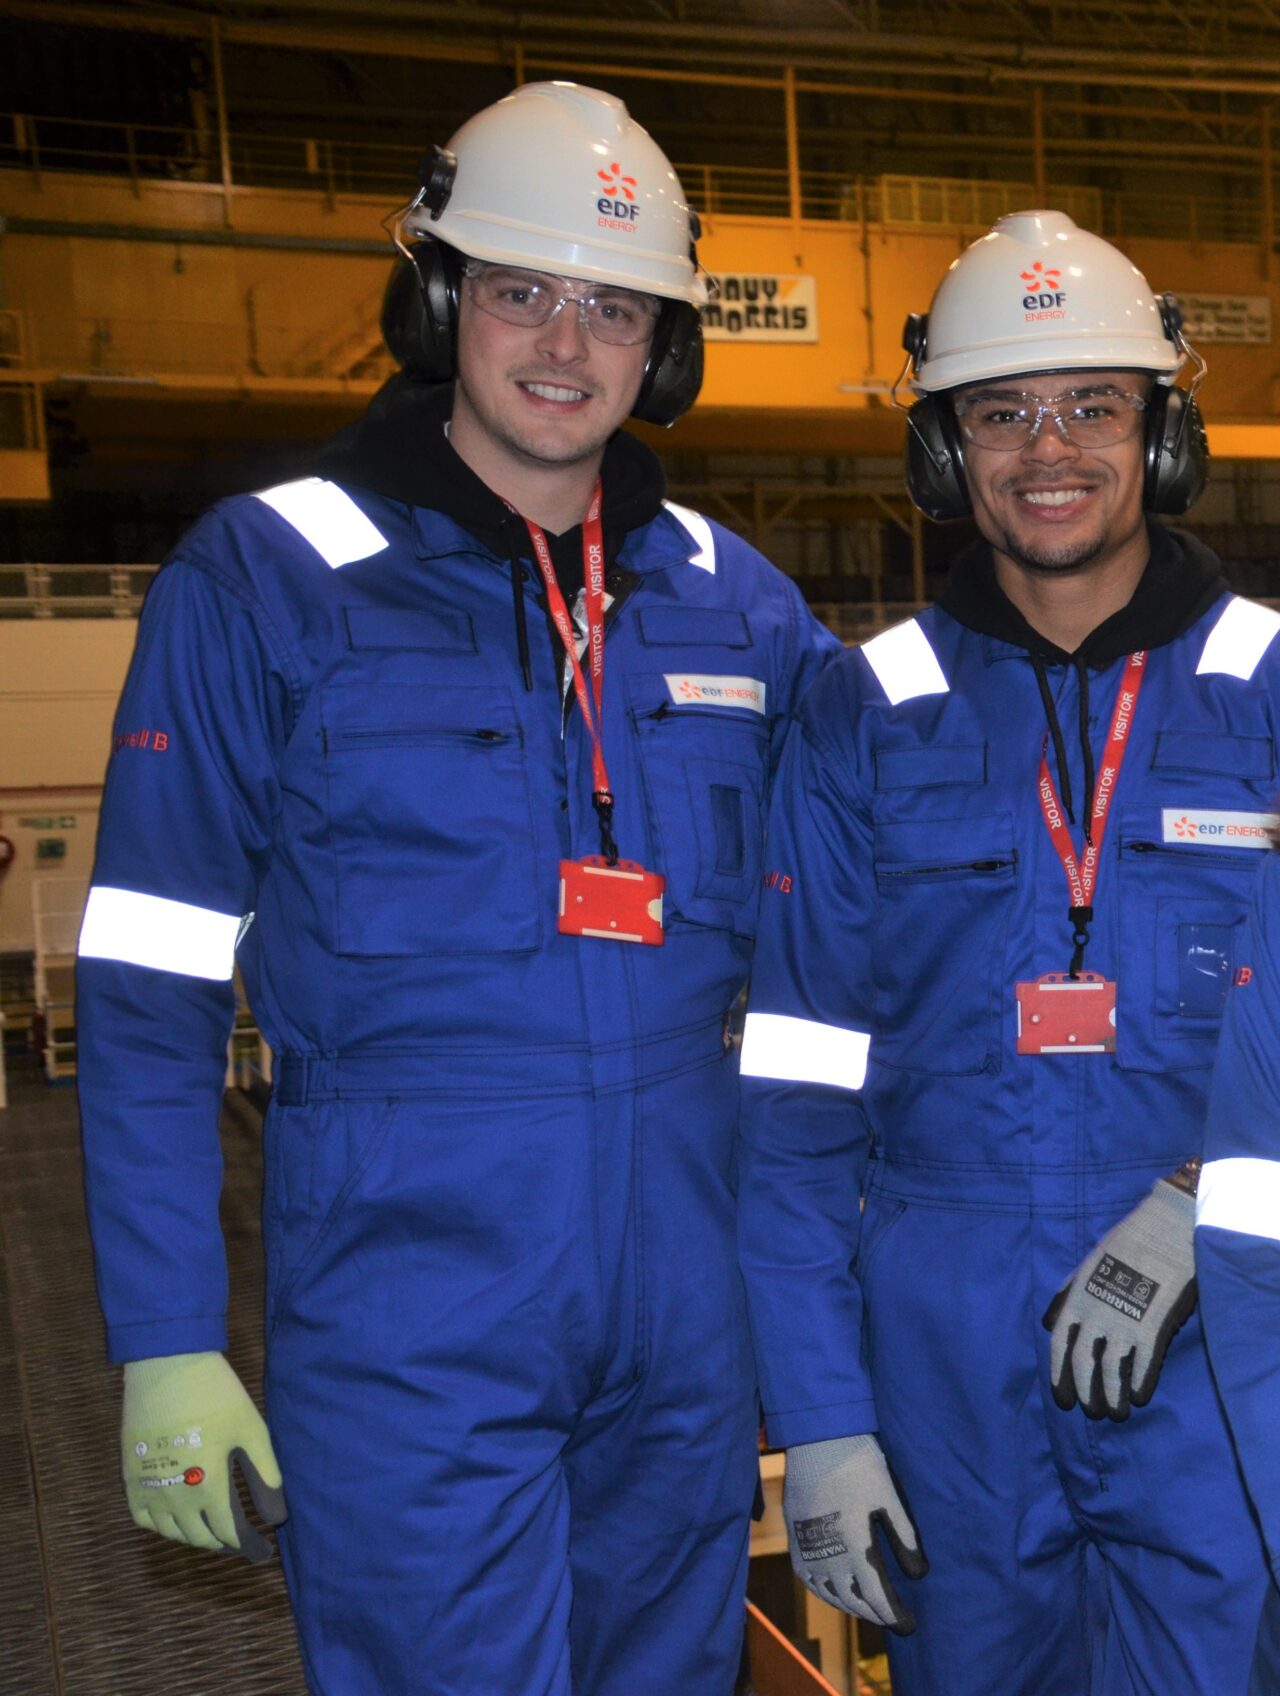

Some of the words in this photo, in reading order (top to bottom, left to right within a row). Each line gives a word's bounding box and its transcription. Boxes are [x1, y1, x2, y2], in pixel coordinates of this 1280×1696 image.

[597, 217, 639, 233] ENERGY
[1024, 310, 1067, 322] ENERGY
[591, 544, 601, 597] VISITOR
[593, 623, 603, 678] VISITOR
[1113, 692, 1134, 742] VISITOR
[1039, 777, 1062, 830] VISITOR
[1094, 767, 1116, 818] VISITOR
[1226, 825, 1266, 838] ENERG
[1064, 856, 1085, 908] VISITOR
[1087, 1281, 1141, 1320] WARRIOR
